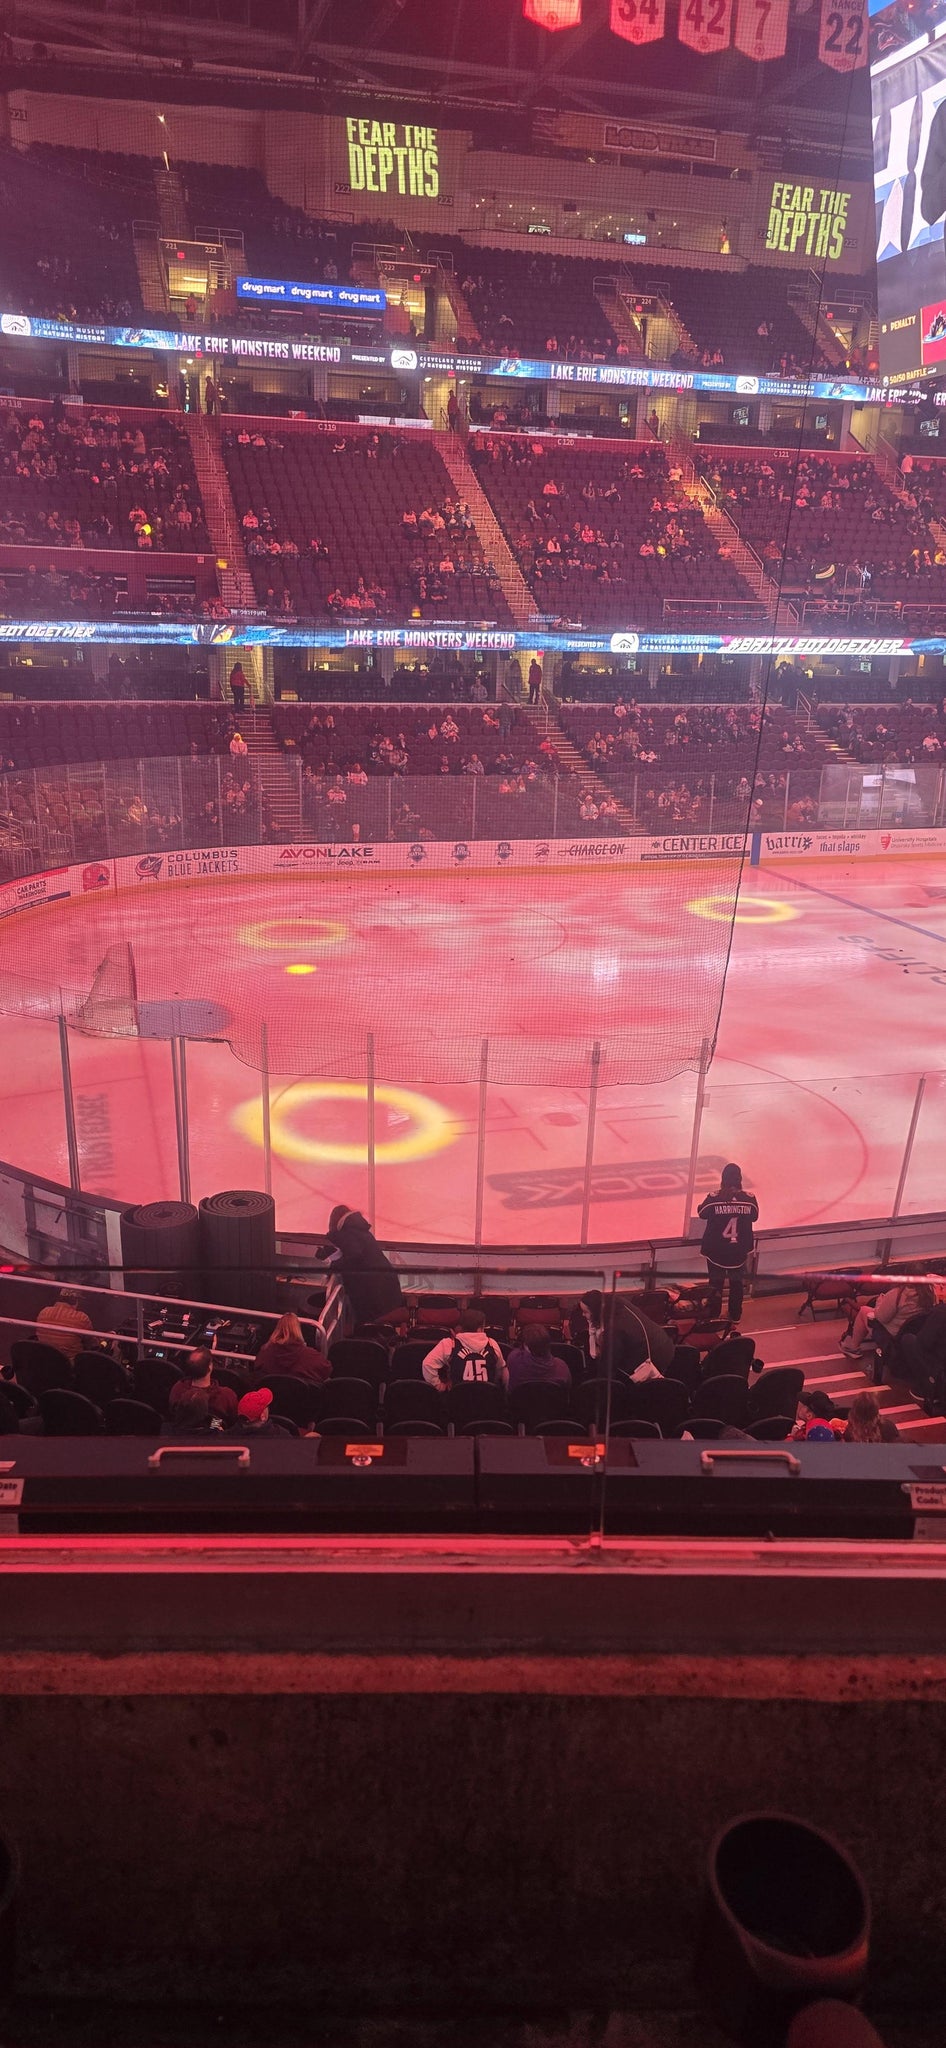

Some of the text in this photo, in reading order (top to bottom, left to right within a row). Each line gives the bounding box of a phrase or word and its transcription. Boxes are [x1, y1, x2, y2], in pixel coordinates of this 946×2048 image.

[686, 0, 727, 35] 42
[755, 1, 771, 40] 7
[825, 13, 863, 54] 22
[346, 117, 438, 152] FEAR THE
[348, 142, 439, 198] DEPTHS
[771, 182, 851, 217] FEAR THE
[766, 207, 846, 259] DEPTHS
[242, 281, 380, 304] drug mart drug mart drug mart
[890, 316, 916, 331] PENALTY
[174, 334, 340, 362] LAKE ERIE MONSTERS WEEKEND
[550, 364, 694, 389] LAKE ERIE MONSTERS WEEKEND
[890, 374, 905, 384] 50/50
[906, 368, 928, 380] RAFFLE
[866, 388, 886, 402] LAKE
[346, 630, 516, 649] LAKE ERIE MONSTERS WEEKEND
[728, 638, 904, 652] #BATTLEDTOGETHER
[569, 844, 624, 856] CHARGE ON
[663, 836, 742, 851] CENTER ICE
[820, 841, 860, 853] that slaps
[168, 850, 238, 862] COLUMBUS
[168, 860, 238, 876] BLUE JACKETS
[17, 880, 46, 894] CAR PARTS
[714, 1206, 752, 1214] HARRINGTON
[722, 1217, 738, 1243] 4
[463, 1360, 488, 1382] 45
